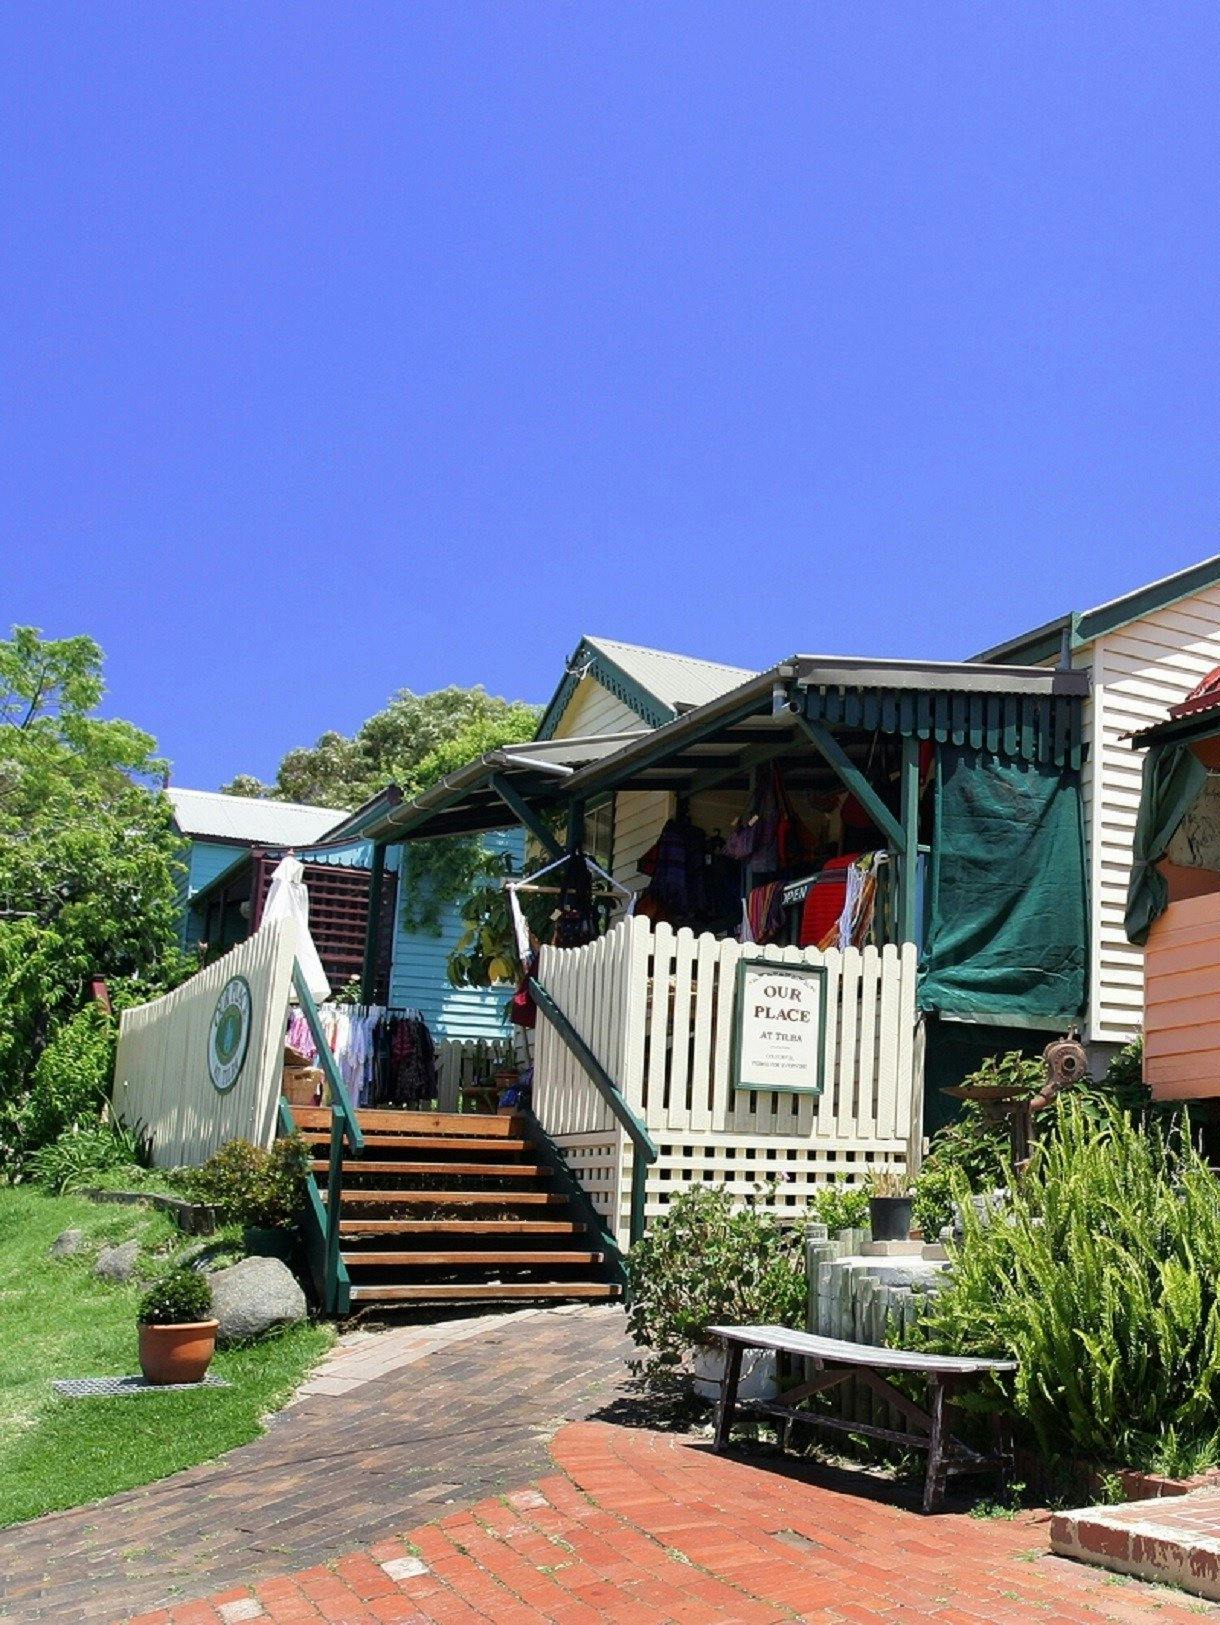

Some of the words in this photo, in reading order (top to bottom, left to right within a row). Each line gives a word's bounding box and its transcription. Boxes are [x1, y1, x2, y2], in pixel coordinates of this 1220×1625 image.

[763, 985, 802, 1002] OUR
[754, 1005, 811, 1023] PLACE
[759, 1031, 772, 1041] AT
[775, 1031, 803, 1043] TILBA
